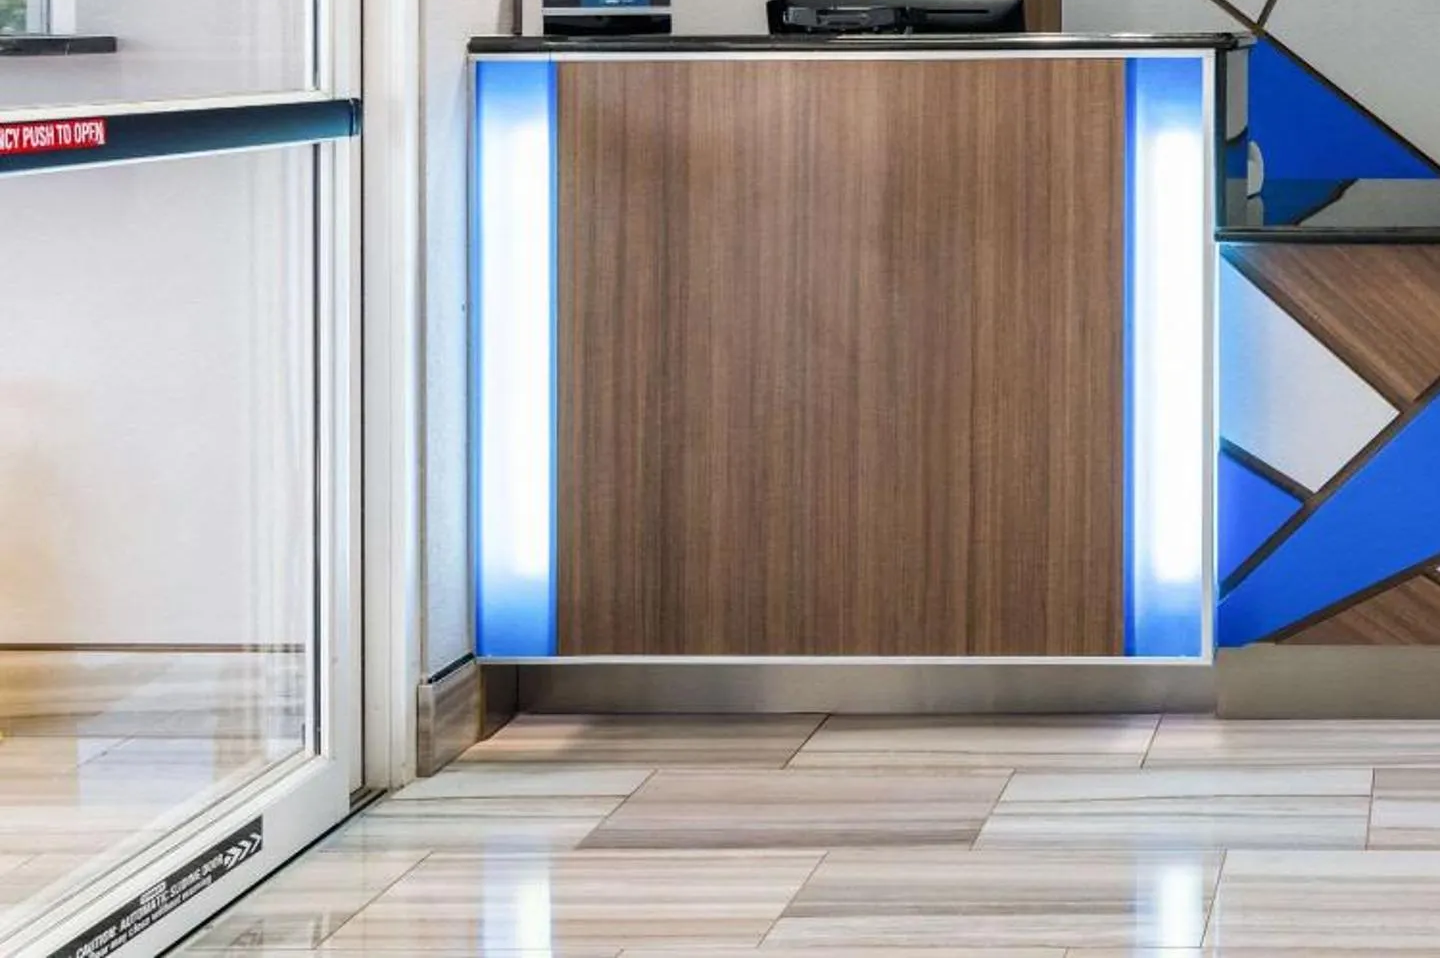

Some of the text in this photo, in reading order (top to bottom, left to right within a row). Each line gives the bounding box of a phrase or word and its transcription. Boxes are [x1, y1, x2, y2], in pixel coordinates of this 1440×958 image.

[22, 124, 55, 148] PUSH
[55, 123, 72, 145] TO
[74, 120, 105, 145] OPEN
